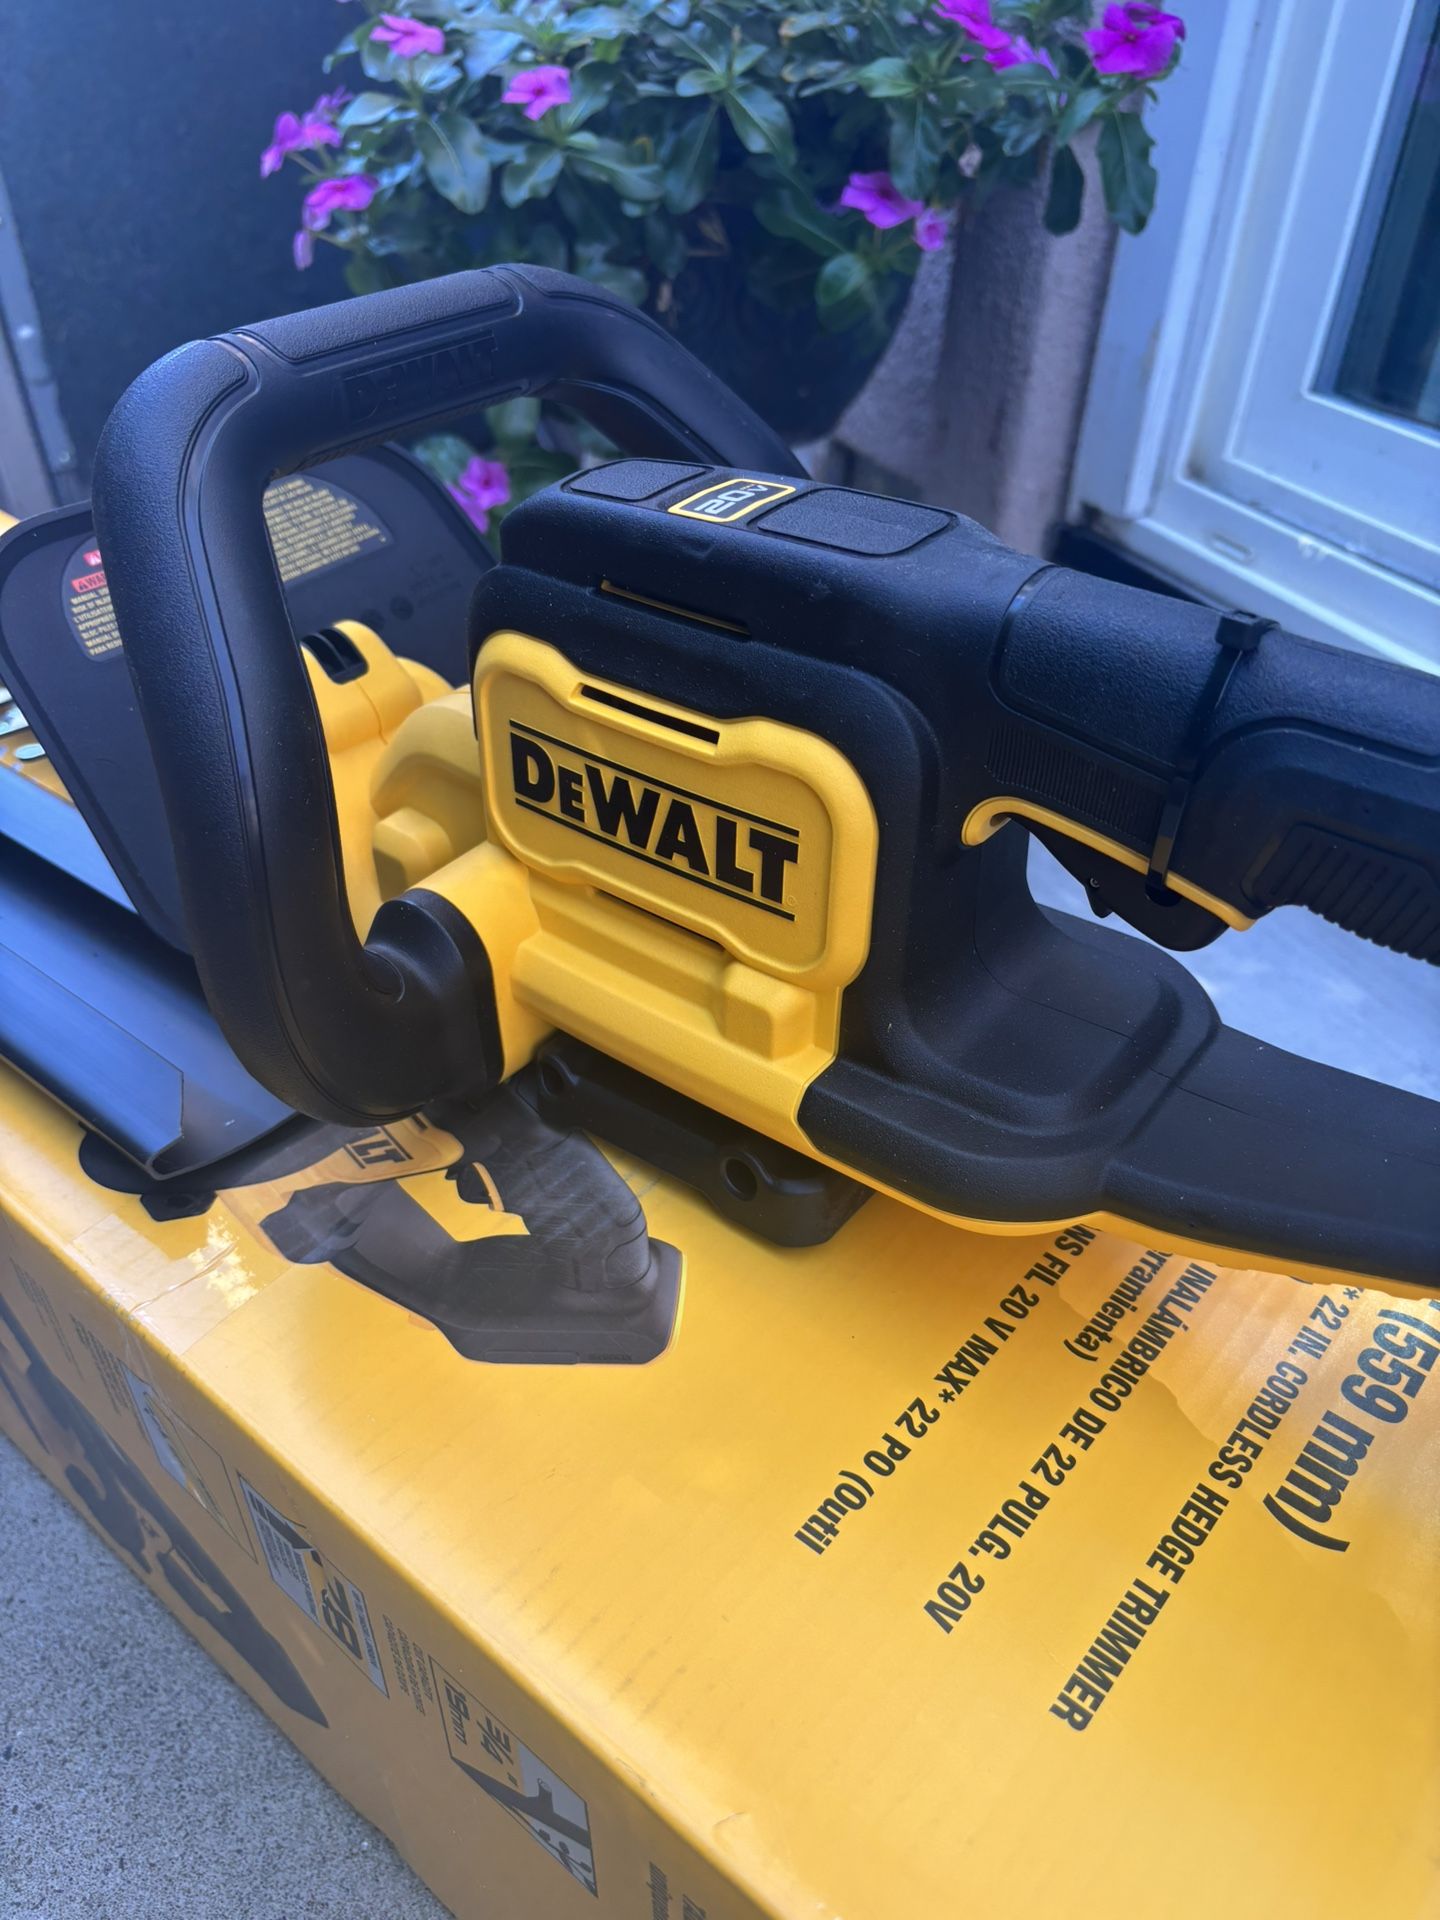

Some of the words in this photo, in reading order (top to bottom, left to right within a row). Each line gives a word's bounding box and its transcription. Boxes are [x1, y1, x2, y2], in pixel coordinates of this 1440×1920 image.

[509, 731, 799, 905] DEWALT
[351, 1129, 407, 1165] LT
[1024, 1251, 1070, 1287] FIL
[1055, 1224, 1097, 1257] NS
[983, 1316, 1016, 1342] V
[999, 1284, 1040, 1320] 20
[1063, 1250, 1174, 1362] rramienta)
[1309, 1294, 1350, 1330] 22
[1089, 1262, 1218, 1412] INALÁMBRICO
[1288, 1325, 1332, 1361] IN.
[1340, 1308, 1440, 1425] (559
[894, 1396, 941, 1439] 22
[1059, 1407, 1108, 1451] DE
[1208, 1360, 1309, 1489] CORDLESS
[863, 1432, 912, 1477] PO
[1030, 1442, 1077, 1487] 22
[1262, 1409, 1376, 1553] mm)
[794, 1469, 875, 1556] (Outil
[968, 1480, 1051, 1560] PULG.
[1145, 1481, 1230, 1585] HEDGE
[923, 1560, 986, 1635] 20V
[1048, 1577, 1171, 1732] TRIMMER
